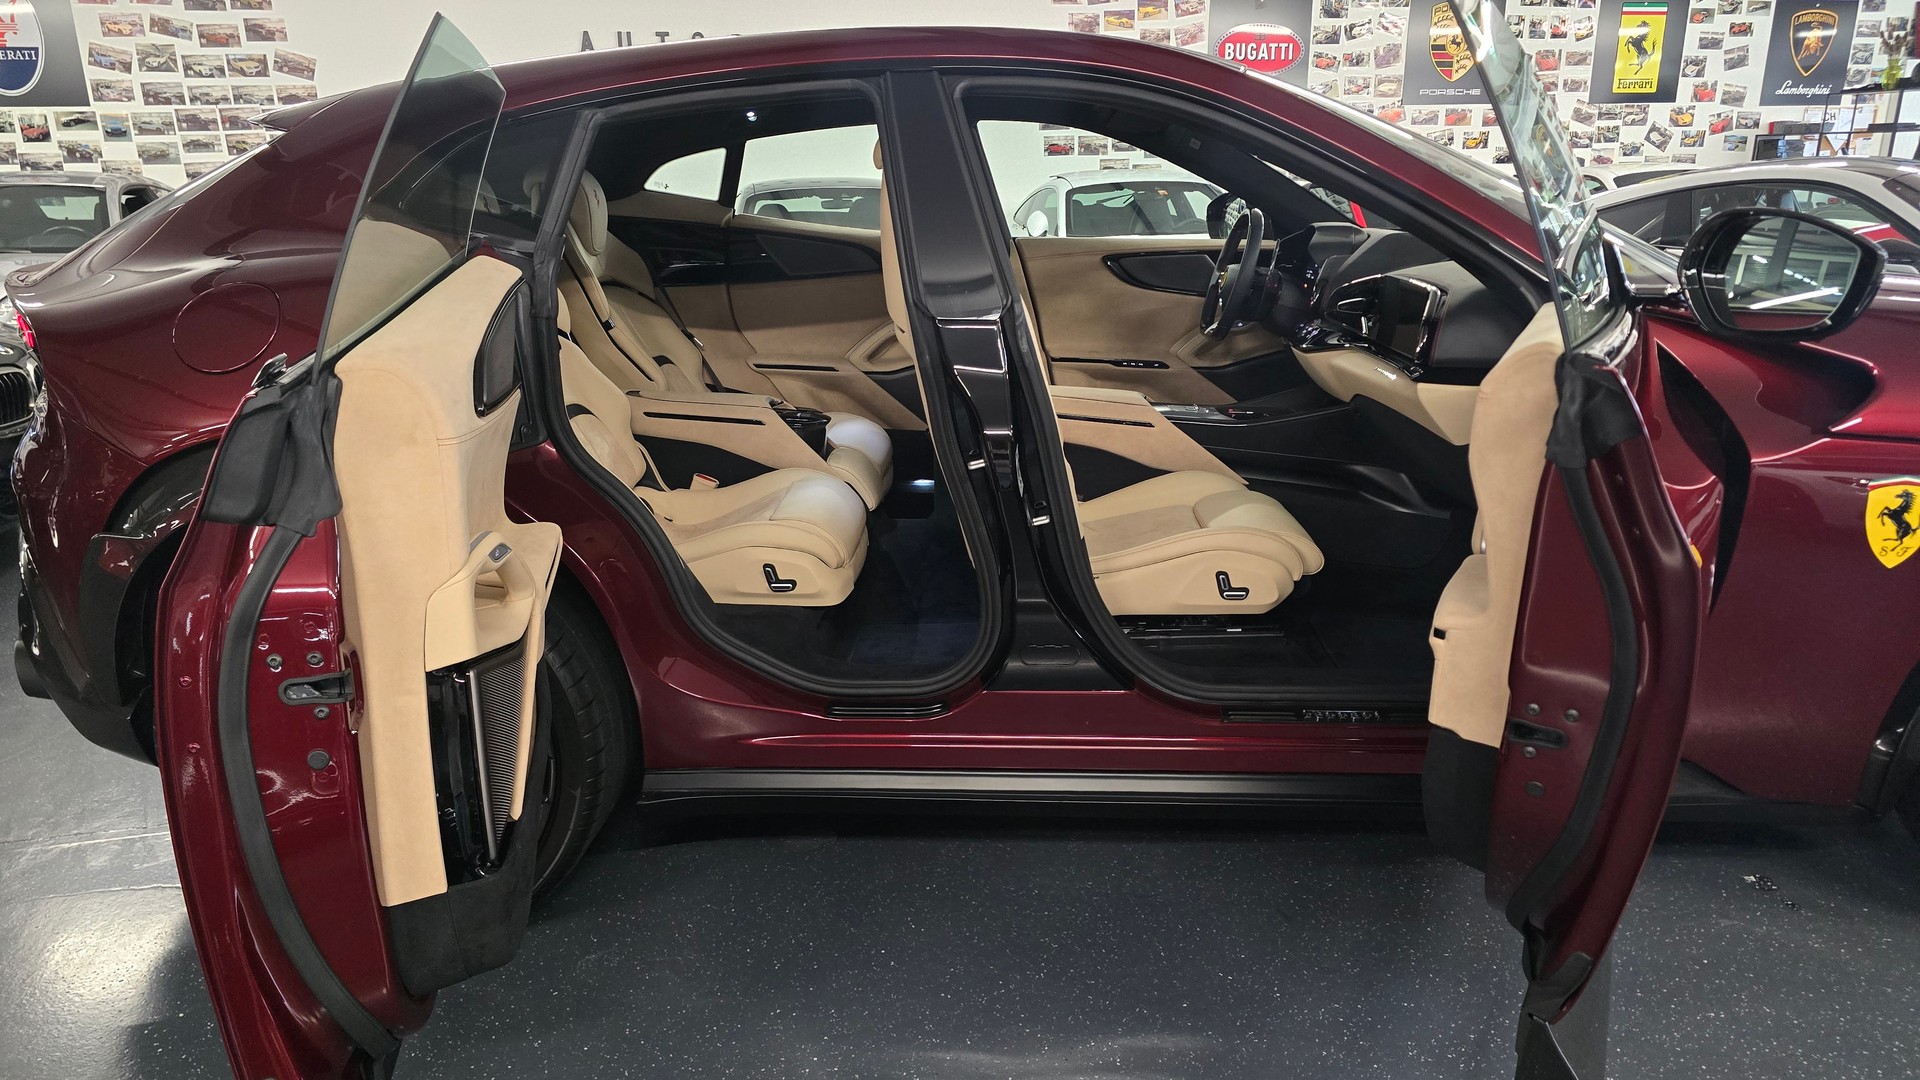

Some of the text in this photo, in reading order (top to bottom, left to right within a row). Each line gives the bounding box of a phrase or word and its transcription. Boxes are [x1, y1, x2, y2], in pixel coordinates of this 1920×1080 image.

[1795, 13, 1836, 26] LAMBORGHINI
[1224, 42, 1295, 61] BUGATTI
[1616, 77, 1654, 89] Ferrari
[1775, 80, 1832, 98] Lamborghini
[1419, 88, 1482, 96] PORSCHE
